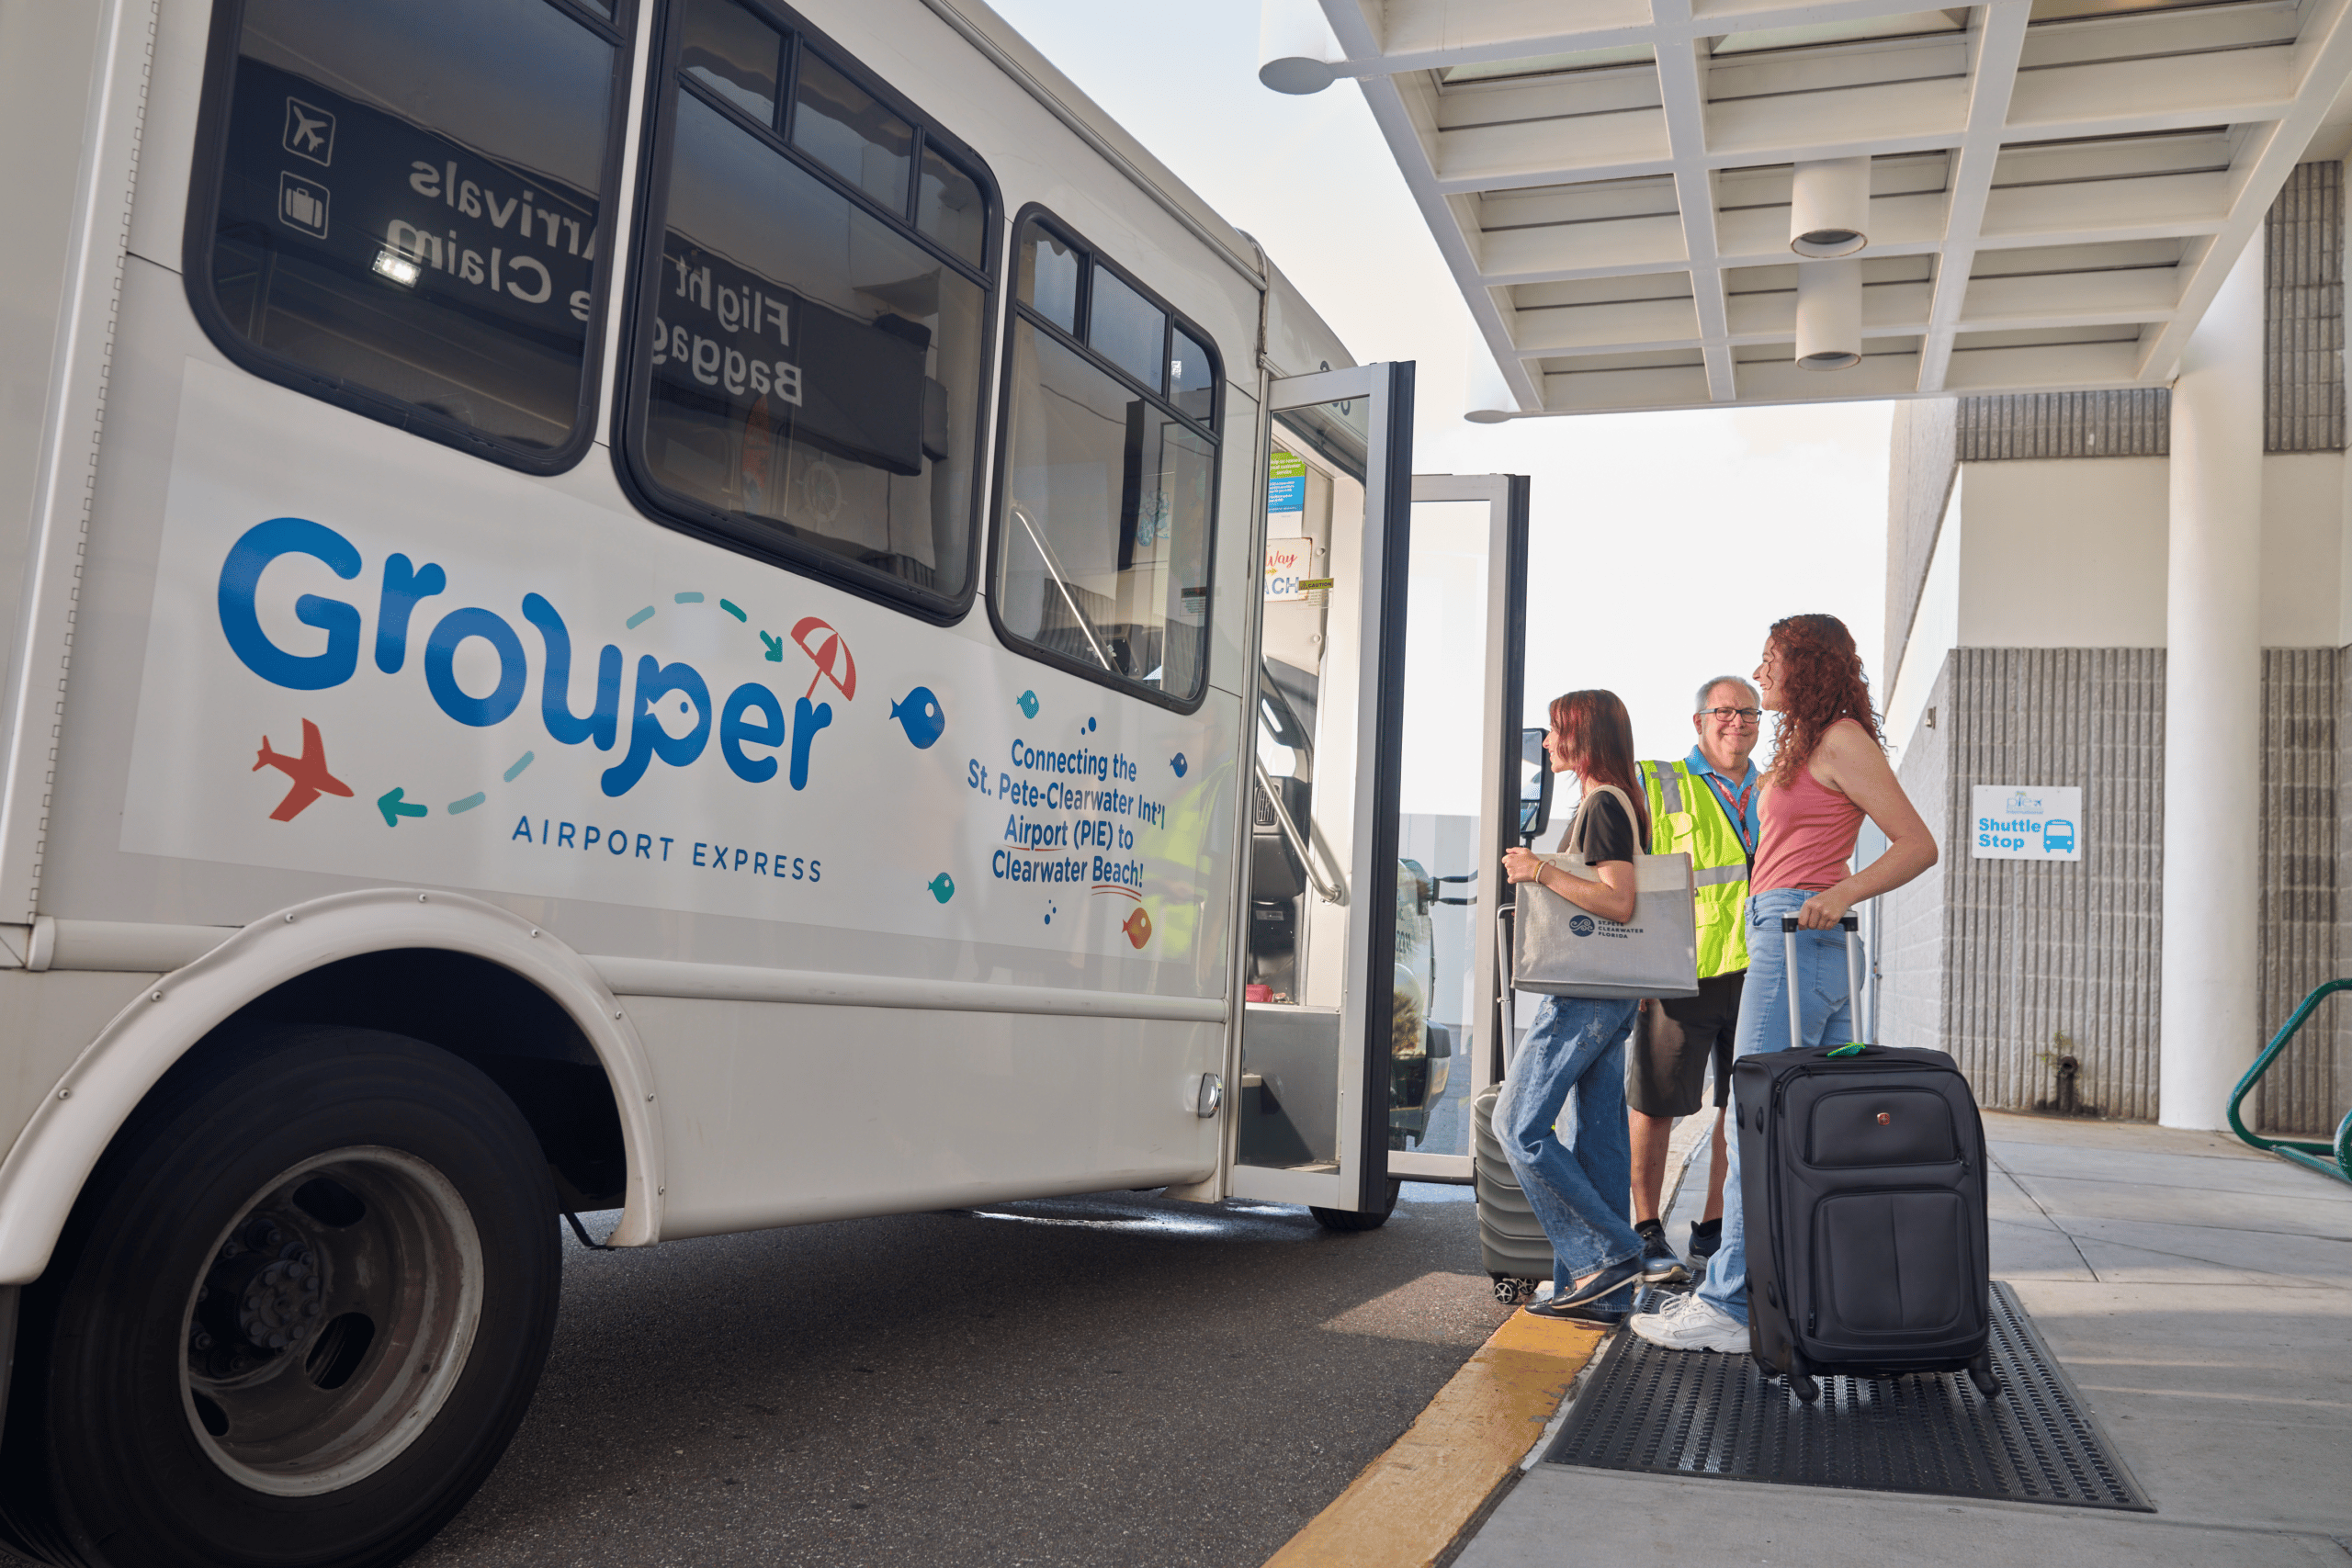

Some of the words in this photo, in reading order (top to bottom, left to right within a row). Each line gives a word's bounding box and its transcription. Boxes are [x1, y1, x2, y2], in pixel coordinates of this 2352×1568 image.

[1265, 550, 1297, 569] Way
[218, 517, 832, 798] Grouper
[1011, 739, 1108, 782] Connecting
[1113, 753, 1136, 782] the
[967, 758, 992, 796] St.
[999, 773, 1134, 816] Pete-Clearwater
[1004, 814, 1069, 851] Airport
[1074, 819, 1114, 851] (PIE)
[1118, 824, 1134, 851] to
[1978, 818, 2041, 832] Shuttle
[1978, 833, 2025, 852] Stop
[512, 815, 674, 862] AIRPORT
[693, 842, 821, 883] EXPRESS
[992, 850, 1088, 883] Clearwater
[1091, 855, 1144, 888] Beach!
[1598, 926, 1644, 934] CLEARWATER
